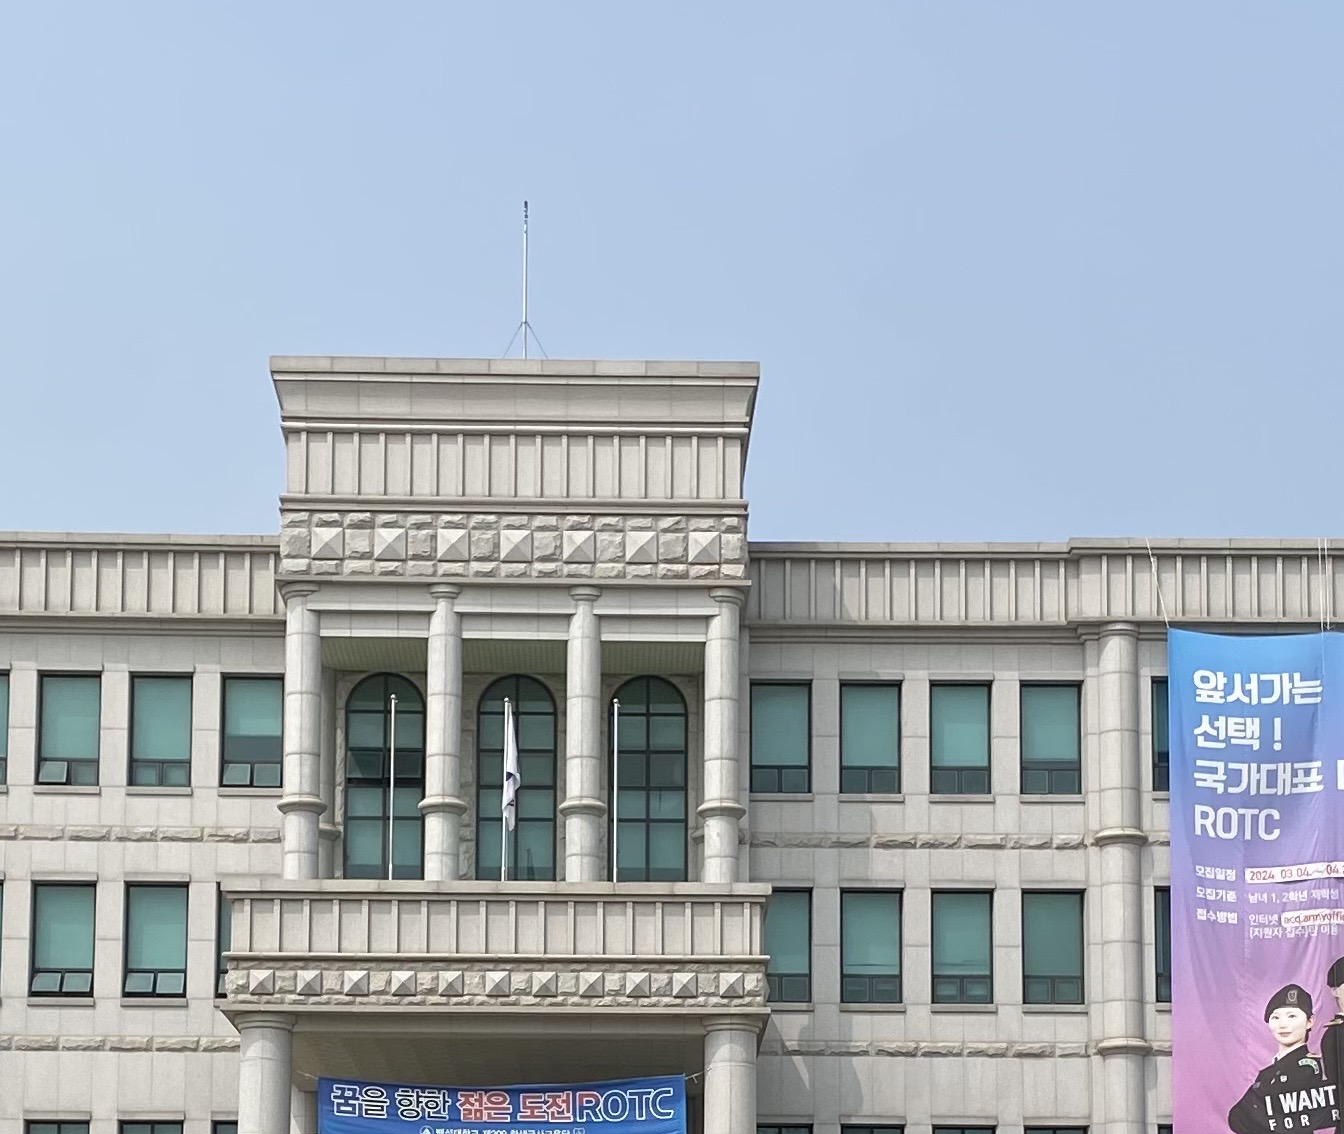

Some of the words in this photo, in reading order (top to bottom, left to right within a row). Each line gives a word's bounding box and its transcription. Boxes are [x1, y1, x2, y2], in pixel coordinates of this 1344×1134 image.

[1192, 669, 1323, 706] 앞서가는
[1192, 714, 1260, 751] 선택
[1193, 760, 1324, 796] 국가대표
[1194, 804, 1281, 841] ROTC
[330, 1084, 390, 1119] 꿈을
[394, 1088, 450, 1122] 향한
[456, 1090, 513, 1123] 젊은
[1265, 1095, 1273, 1116] I
[1279, 1085, 1337, 1114] WANT
[1269, 1114, 1310, 1131] FOR
